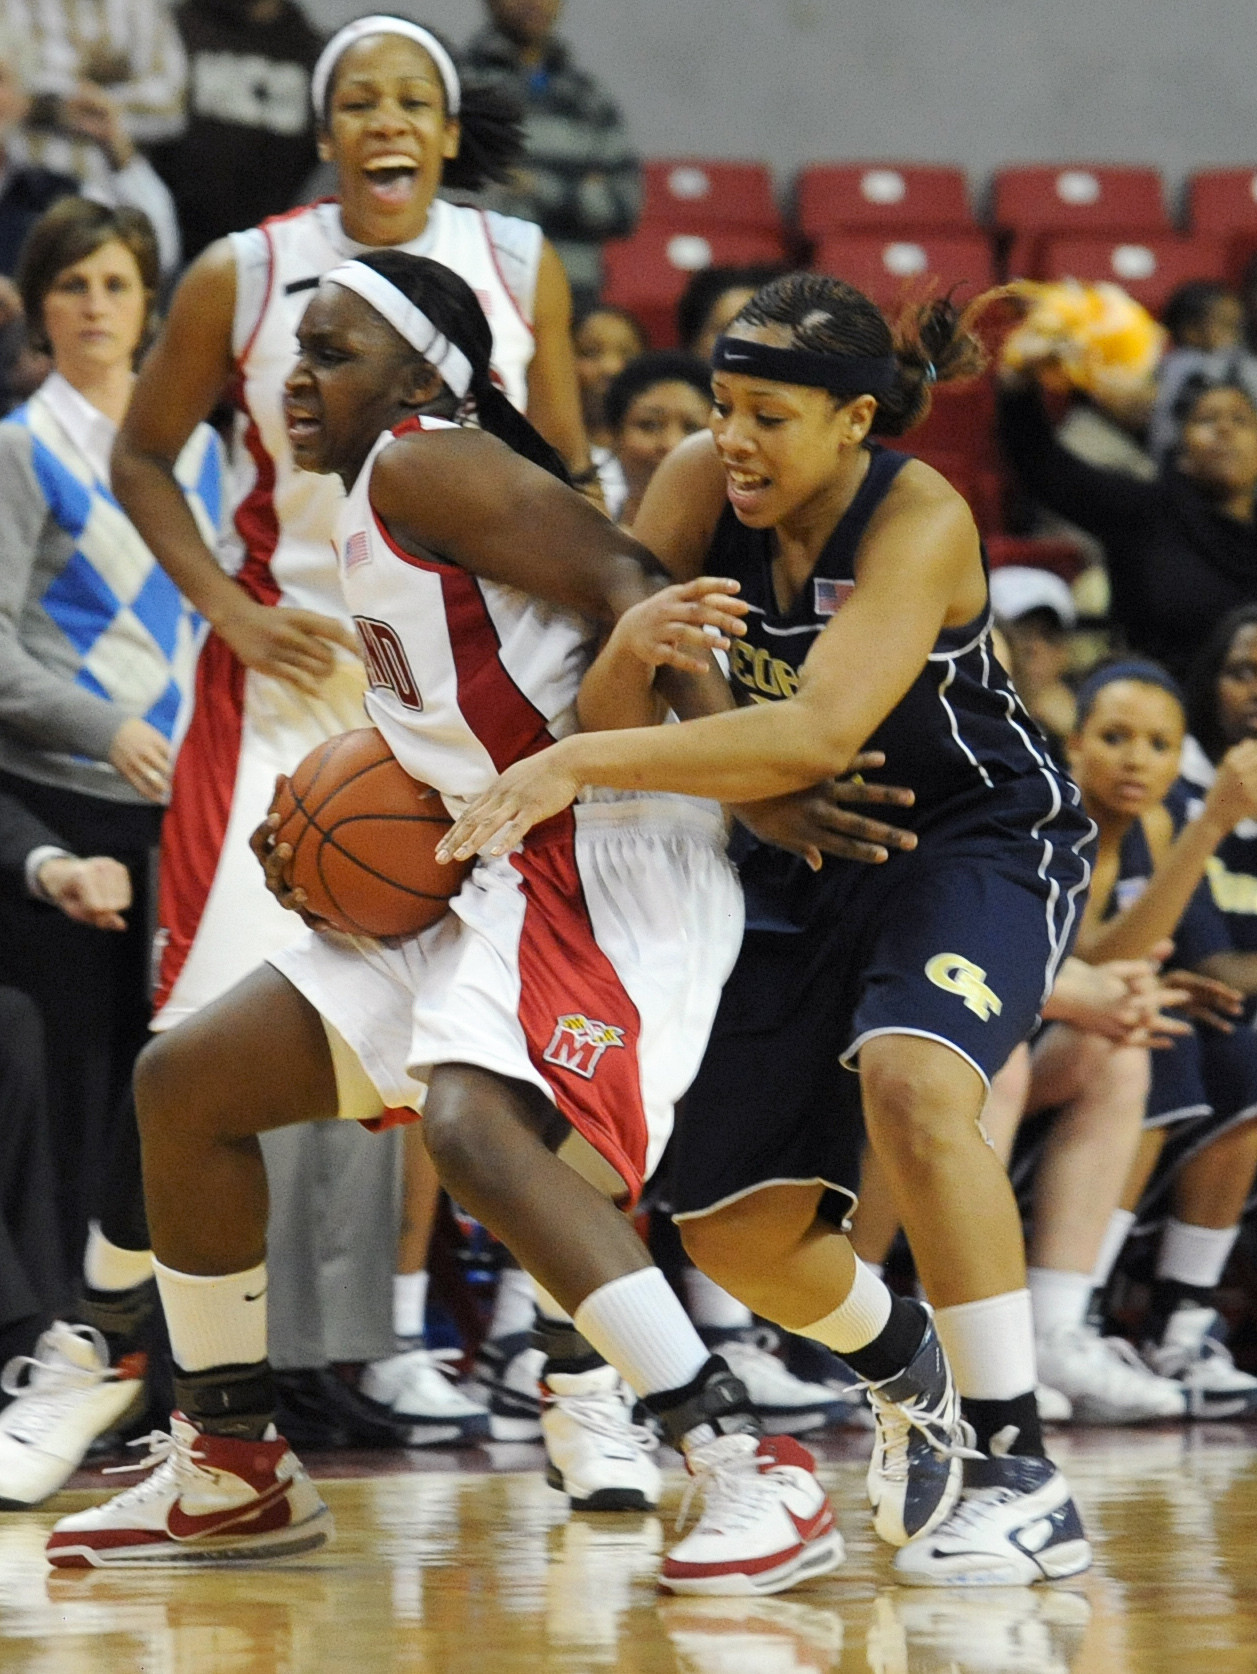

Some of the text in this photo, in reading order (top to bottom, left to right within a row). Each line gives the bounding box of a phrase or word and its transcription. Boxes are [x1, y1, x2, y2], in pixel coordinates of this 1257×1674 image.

[352, 614, 424, 709] ND
[730, 637, 803, 698] EOR
[543, 1013, 612, 1081] M
